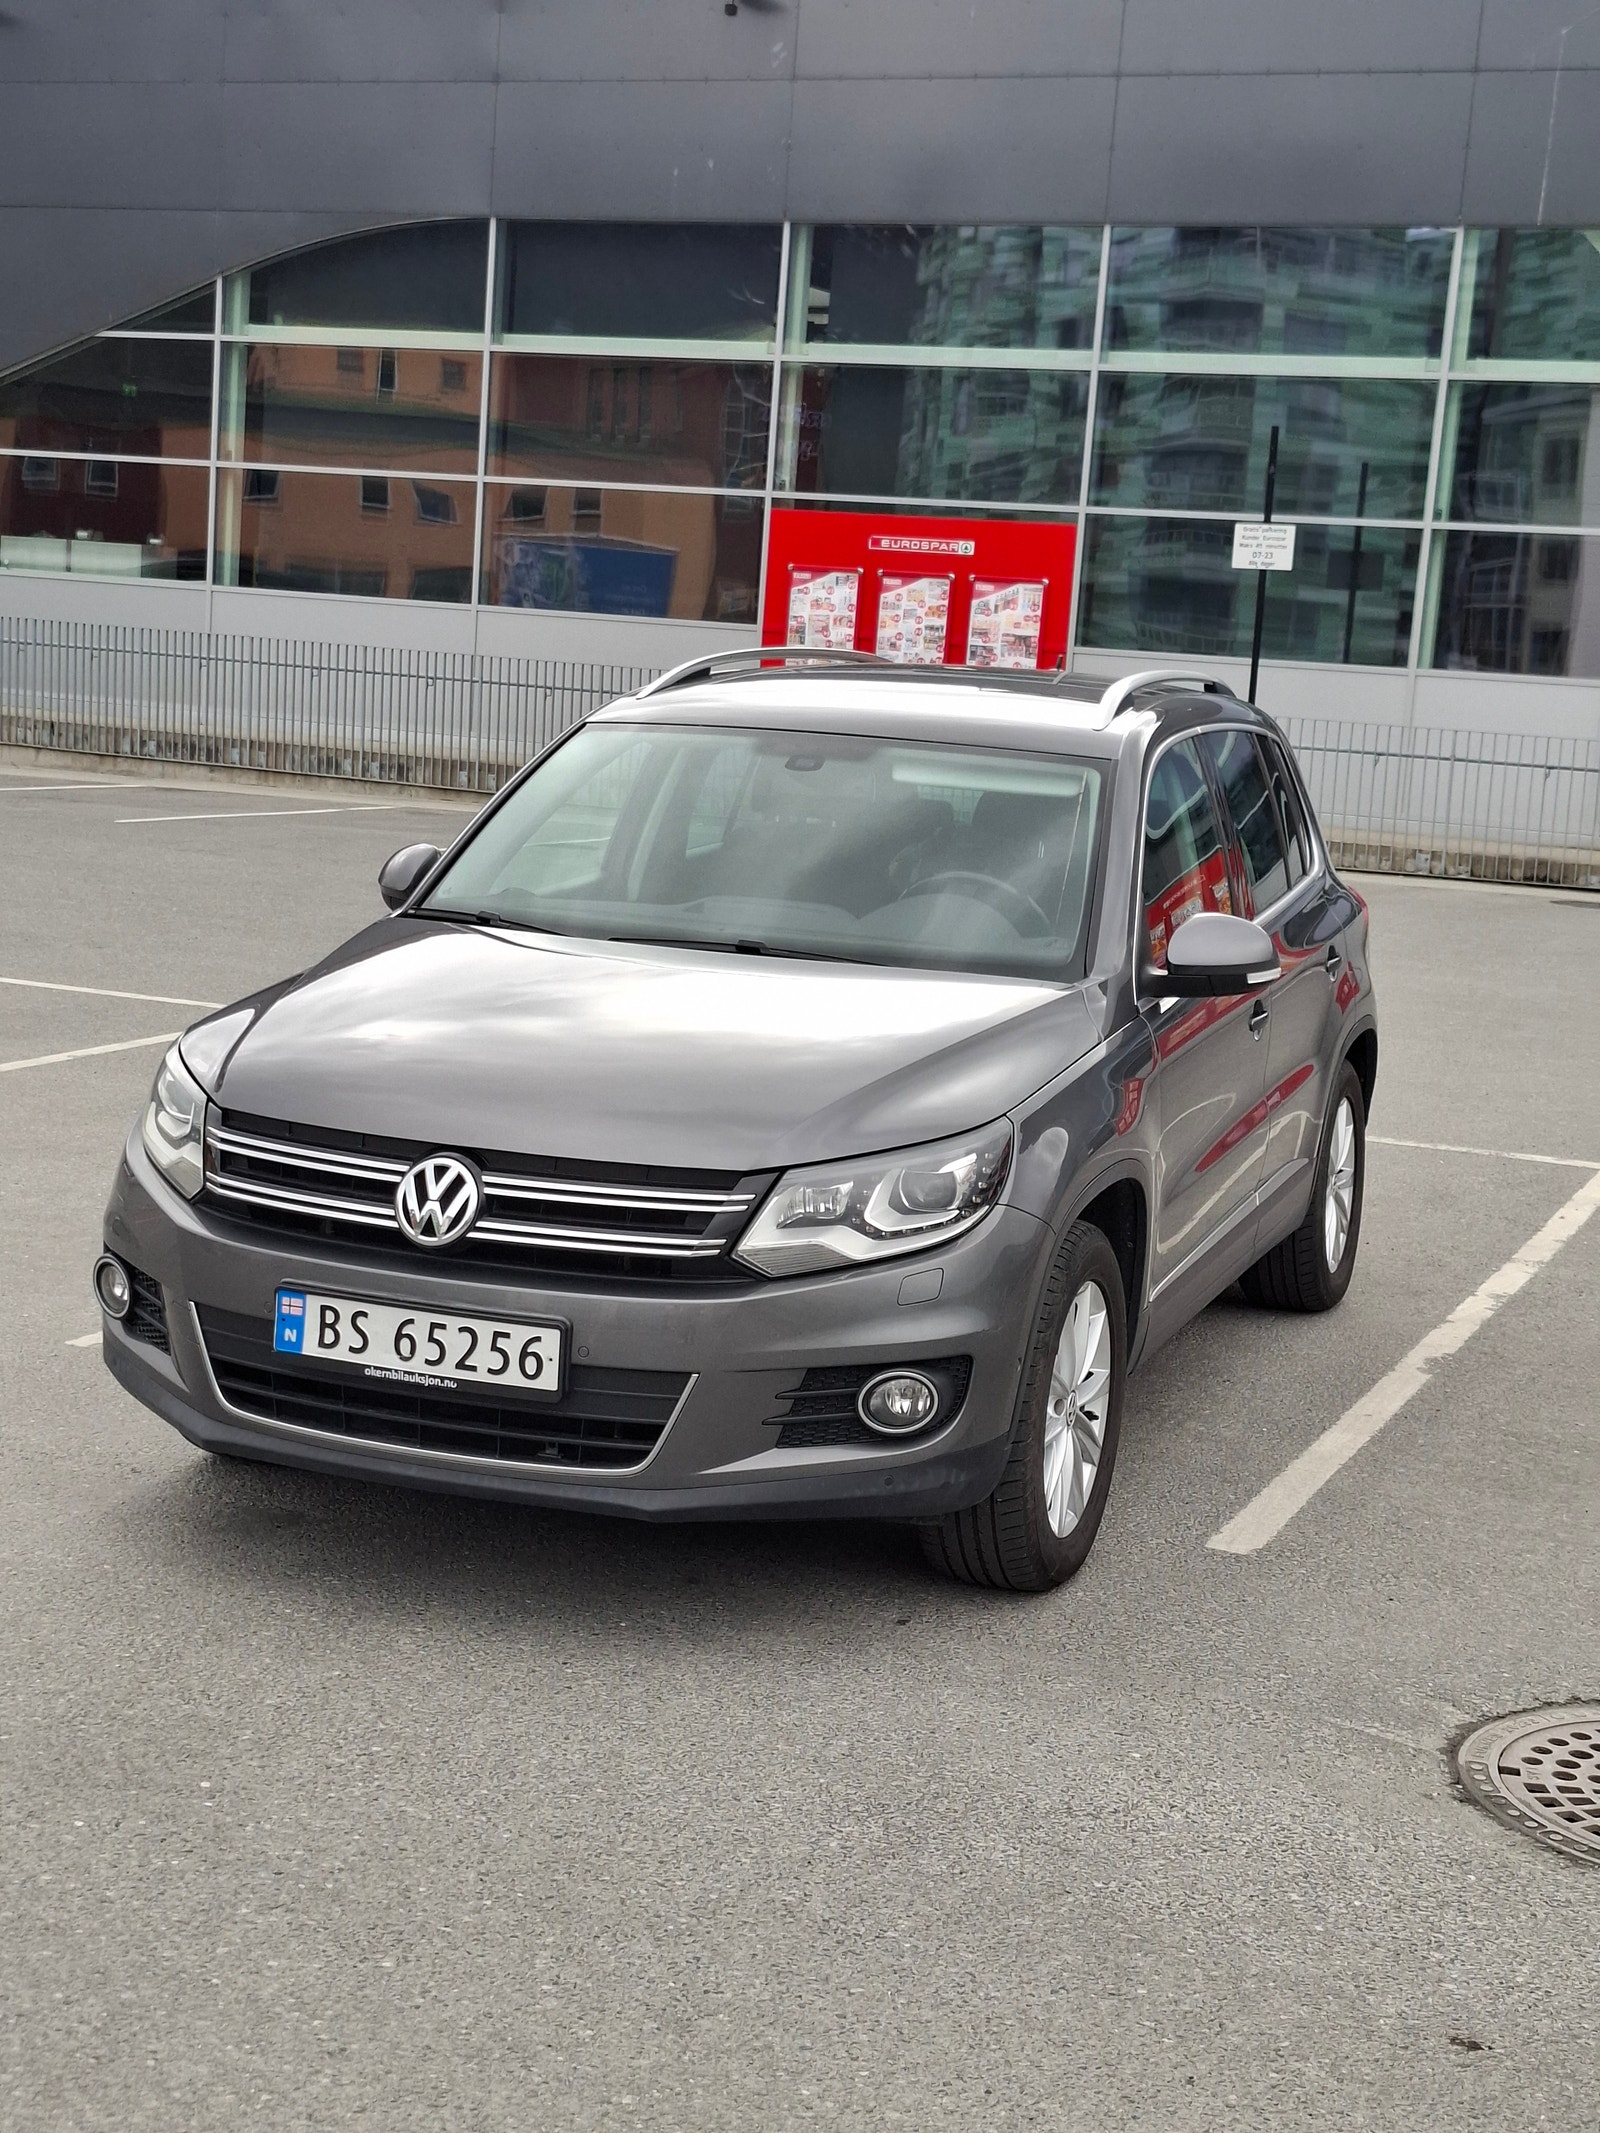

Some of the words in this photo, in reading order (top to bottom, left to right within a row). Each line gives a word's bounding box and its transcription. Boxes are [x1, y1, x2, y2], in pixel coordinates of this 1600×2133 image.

[881, 539, 959, 552] EUROSPAR
[1252, 551, 1273, 559] 07-23
[284, 1328, 297, 1342] N
[317, 1304, 370, 1354] BS
[394, 1317, 544, 1380] 65256
[364, 1366, 458, 1389] okernbilauksjon.no
